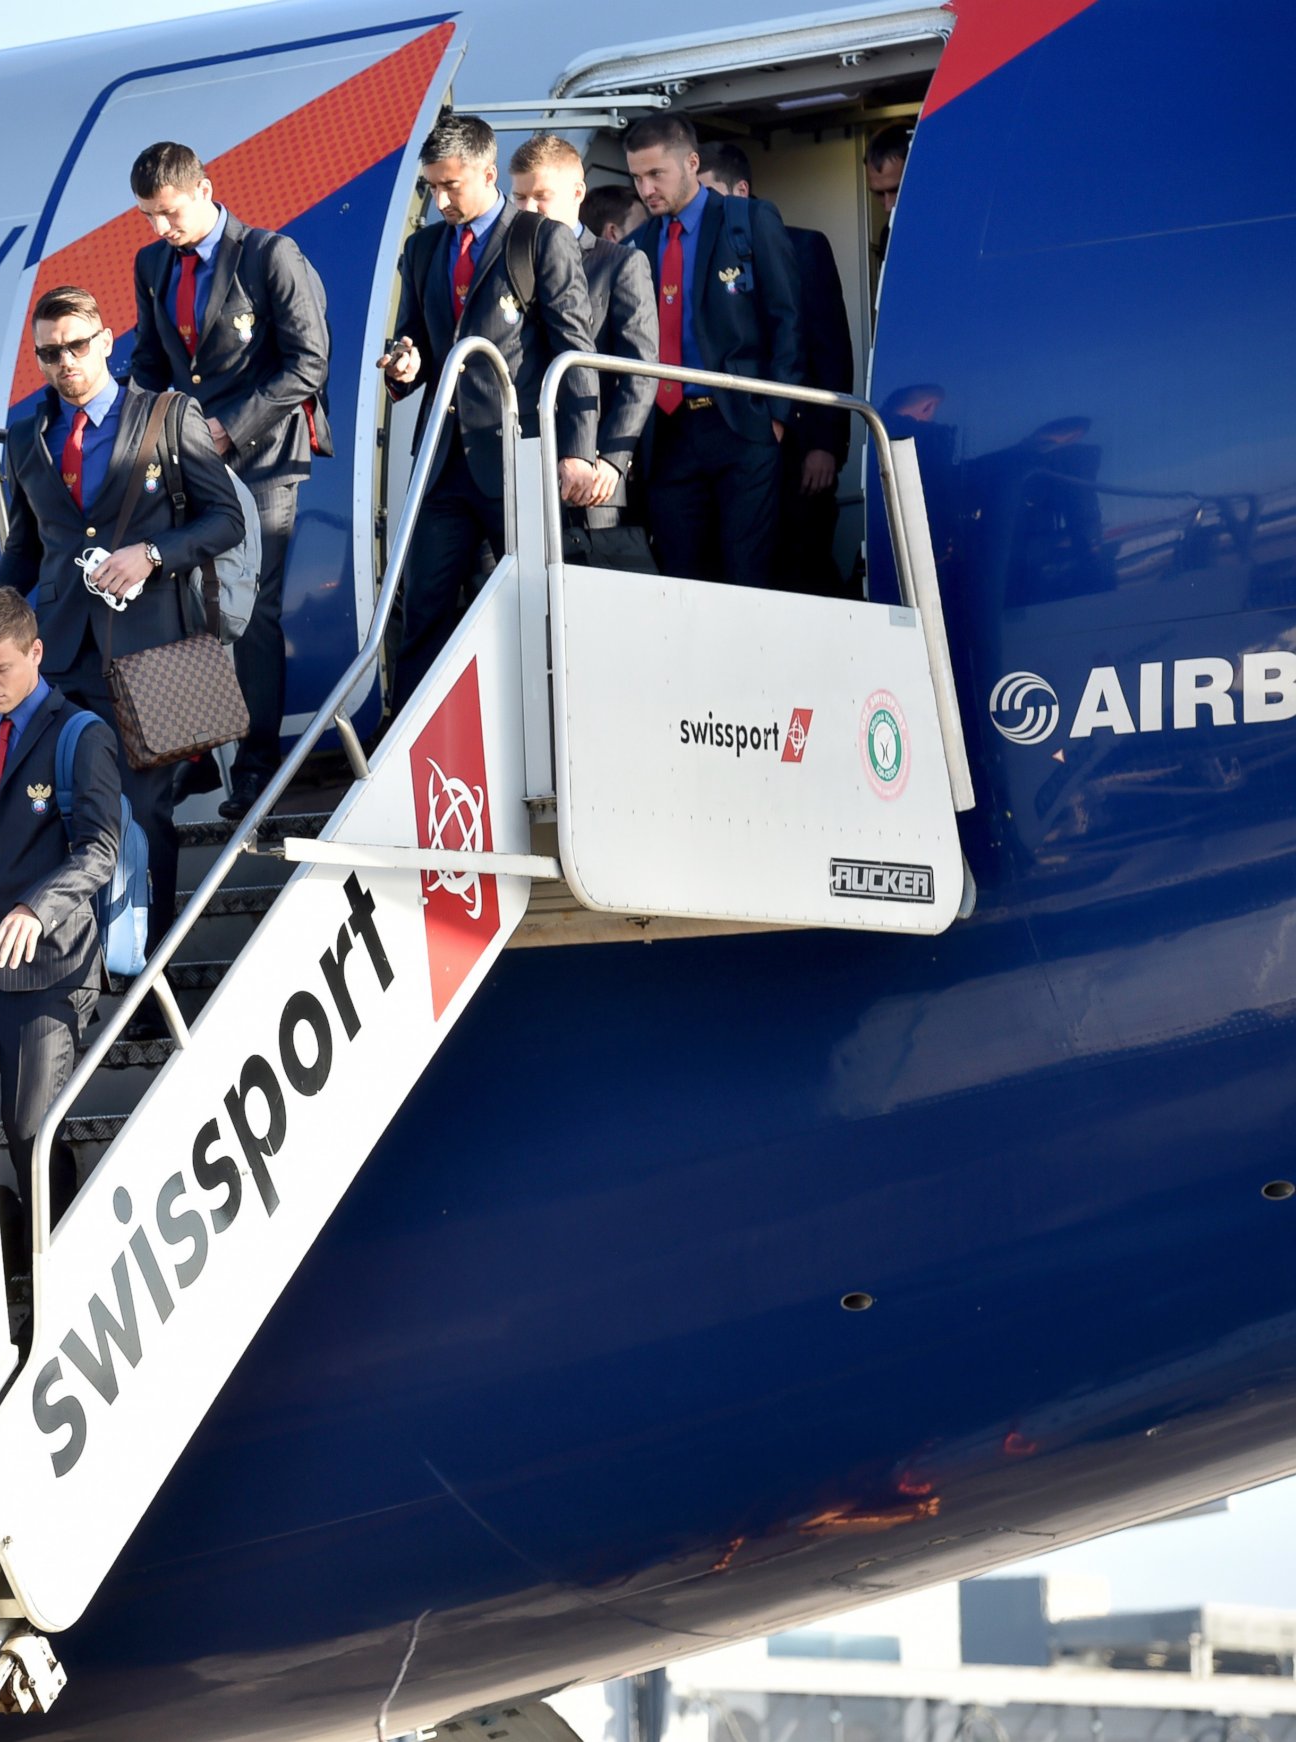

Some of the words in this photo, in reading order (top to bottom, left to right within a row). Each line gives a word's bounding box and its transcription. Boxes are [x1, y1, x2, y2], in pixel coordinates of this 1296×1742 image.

[680, 710, 779, 758] swissport
[834, 865, 930, 897] RUCKER
[31, 870, 396, 1479] swissport
